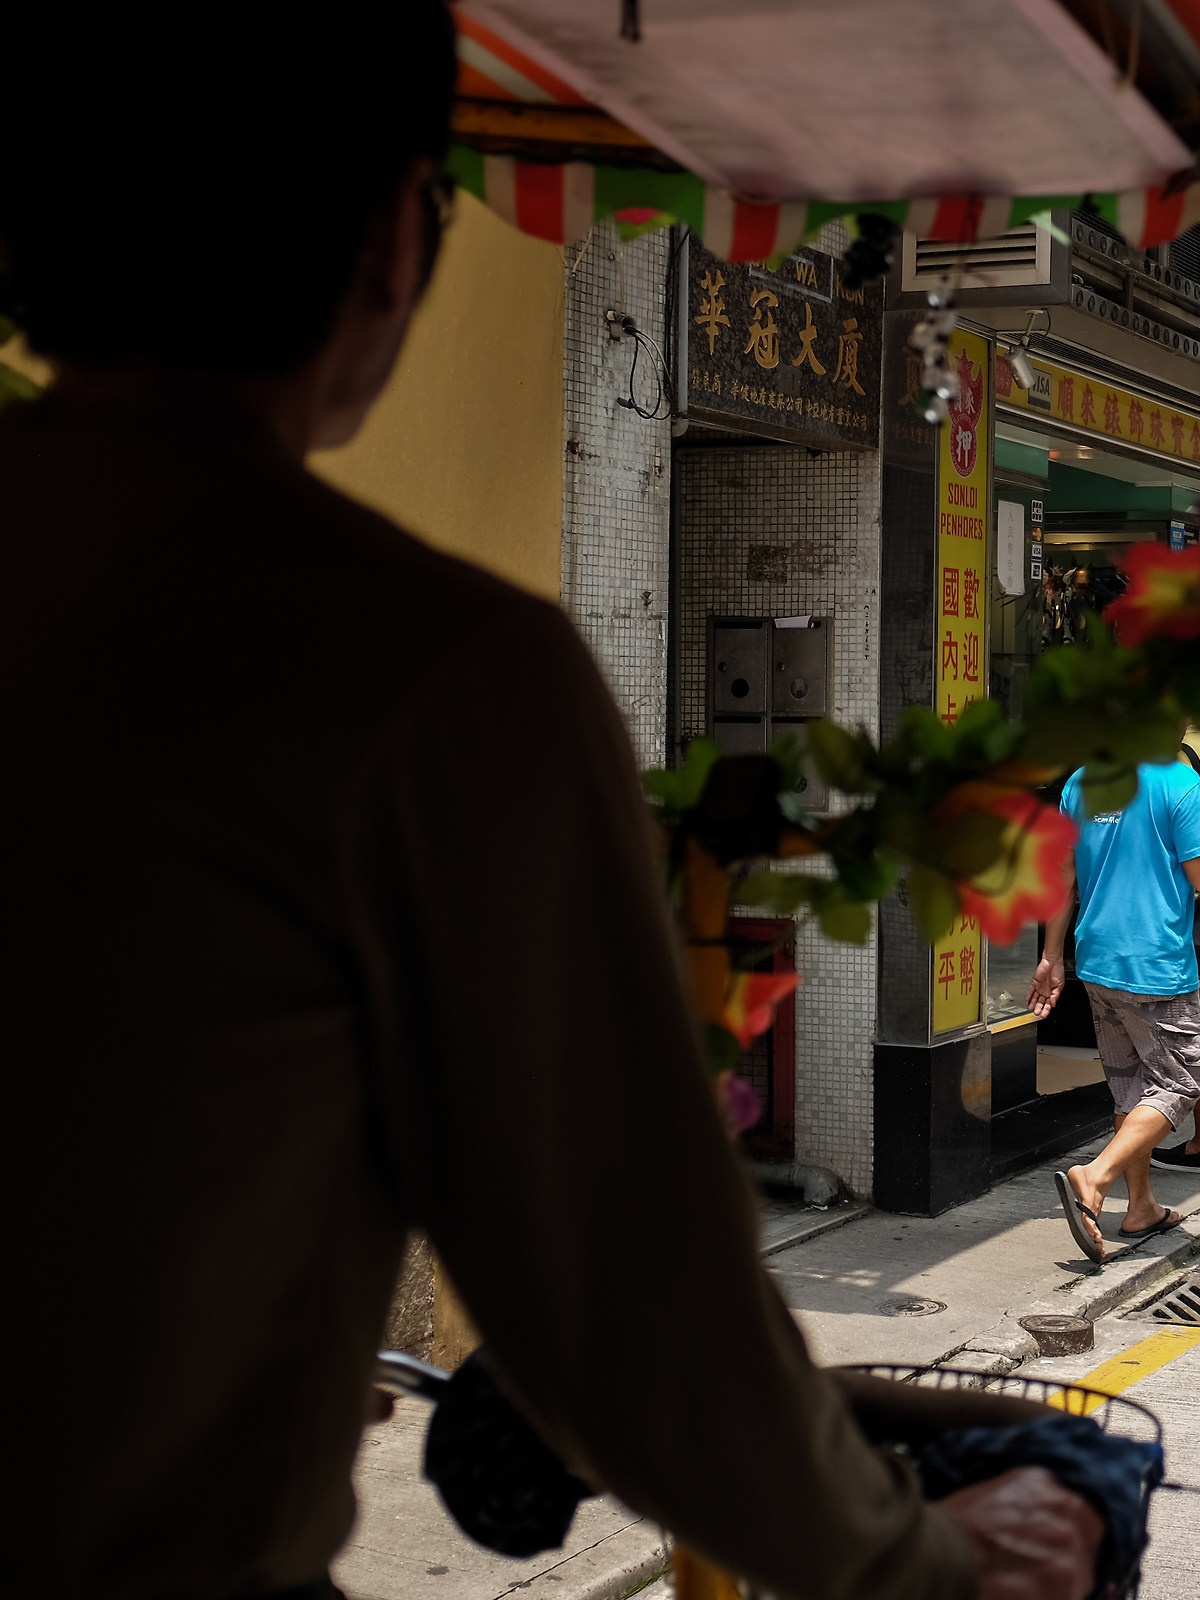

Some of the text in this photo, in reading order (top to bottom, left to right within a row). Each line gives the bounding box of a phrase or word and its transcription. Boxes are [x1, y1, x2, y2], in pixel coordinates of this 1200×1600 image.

[795, 260, 818, 289] WA
[694, 269, 867, 396] 華冠大廈
[955, 426, 973, 468] 押
[948, 482, 978, 509] SONLOI
[940, 512, 983, 541] PENHORES
